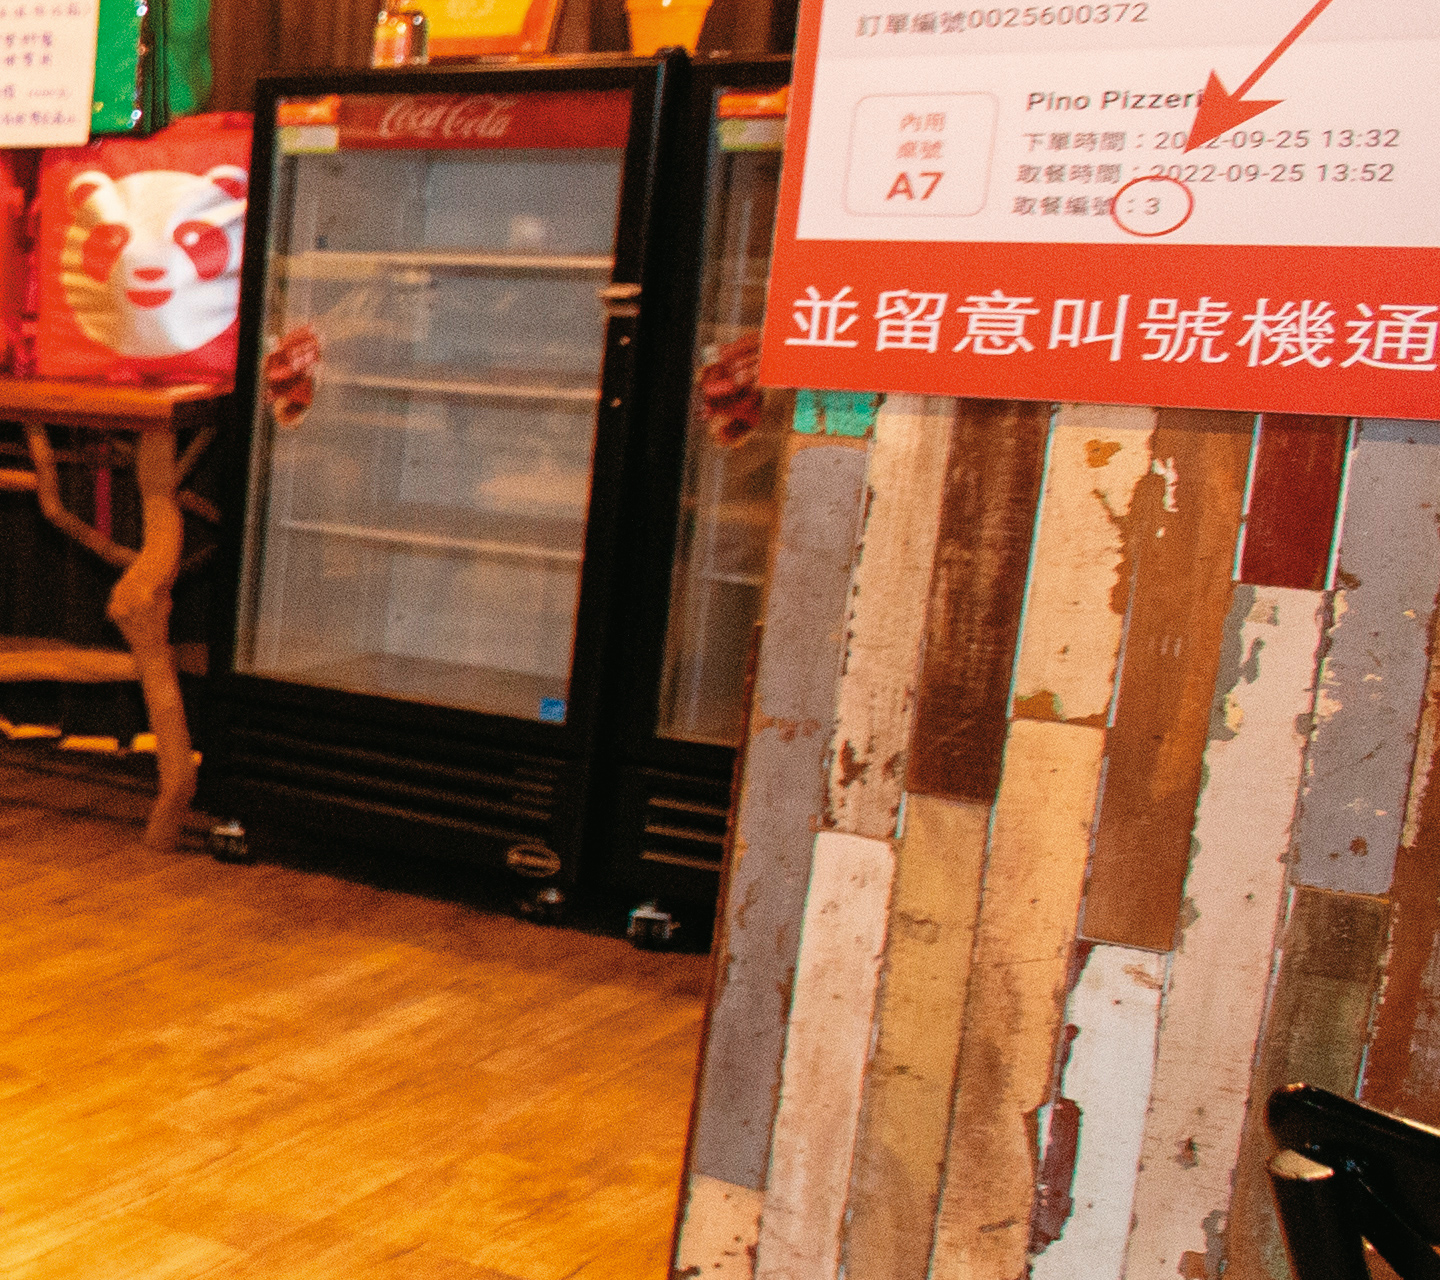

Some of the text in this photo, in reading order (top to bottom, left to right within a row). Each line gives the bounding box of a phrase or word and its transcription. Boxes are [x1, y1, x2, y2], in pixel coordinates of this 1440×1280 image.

[1026, 89, 1206, 112] Pino Pizzeri
[1153, 129, 1310, 150] 202-09-25
[1322, 128, 1400, 148] 13:32
[1148, 163, 1306, 183] 2022-09-25
[1317, 163, 1395, 183] 13:52
[885, 170, 944, 201] A7
[1143, 197, 1161, 216] 3
[784, 285, 1439, 371] 並留意叫號機通
